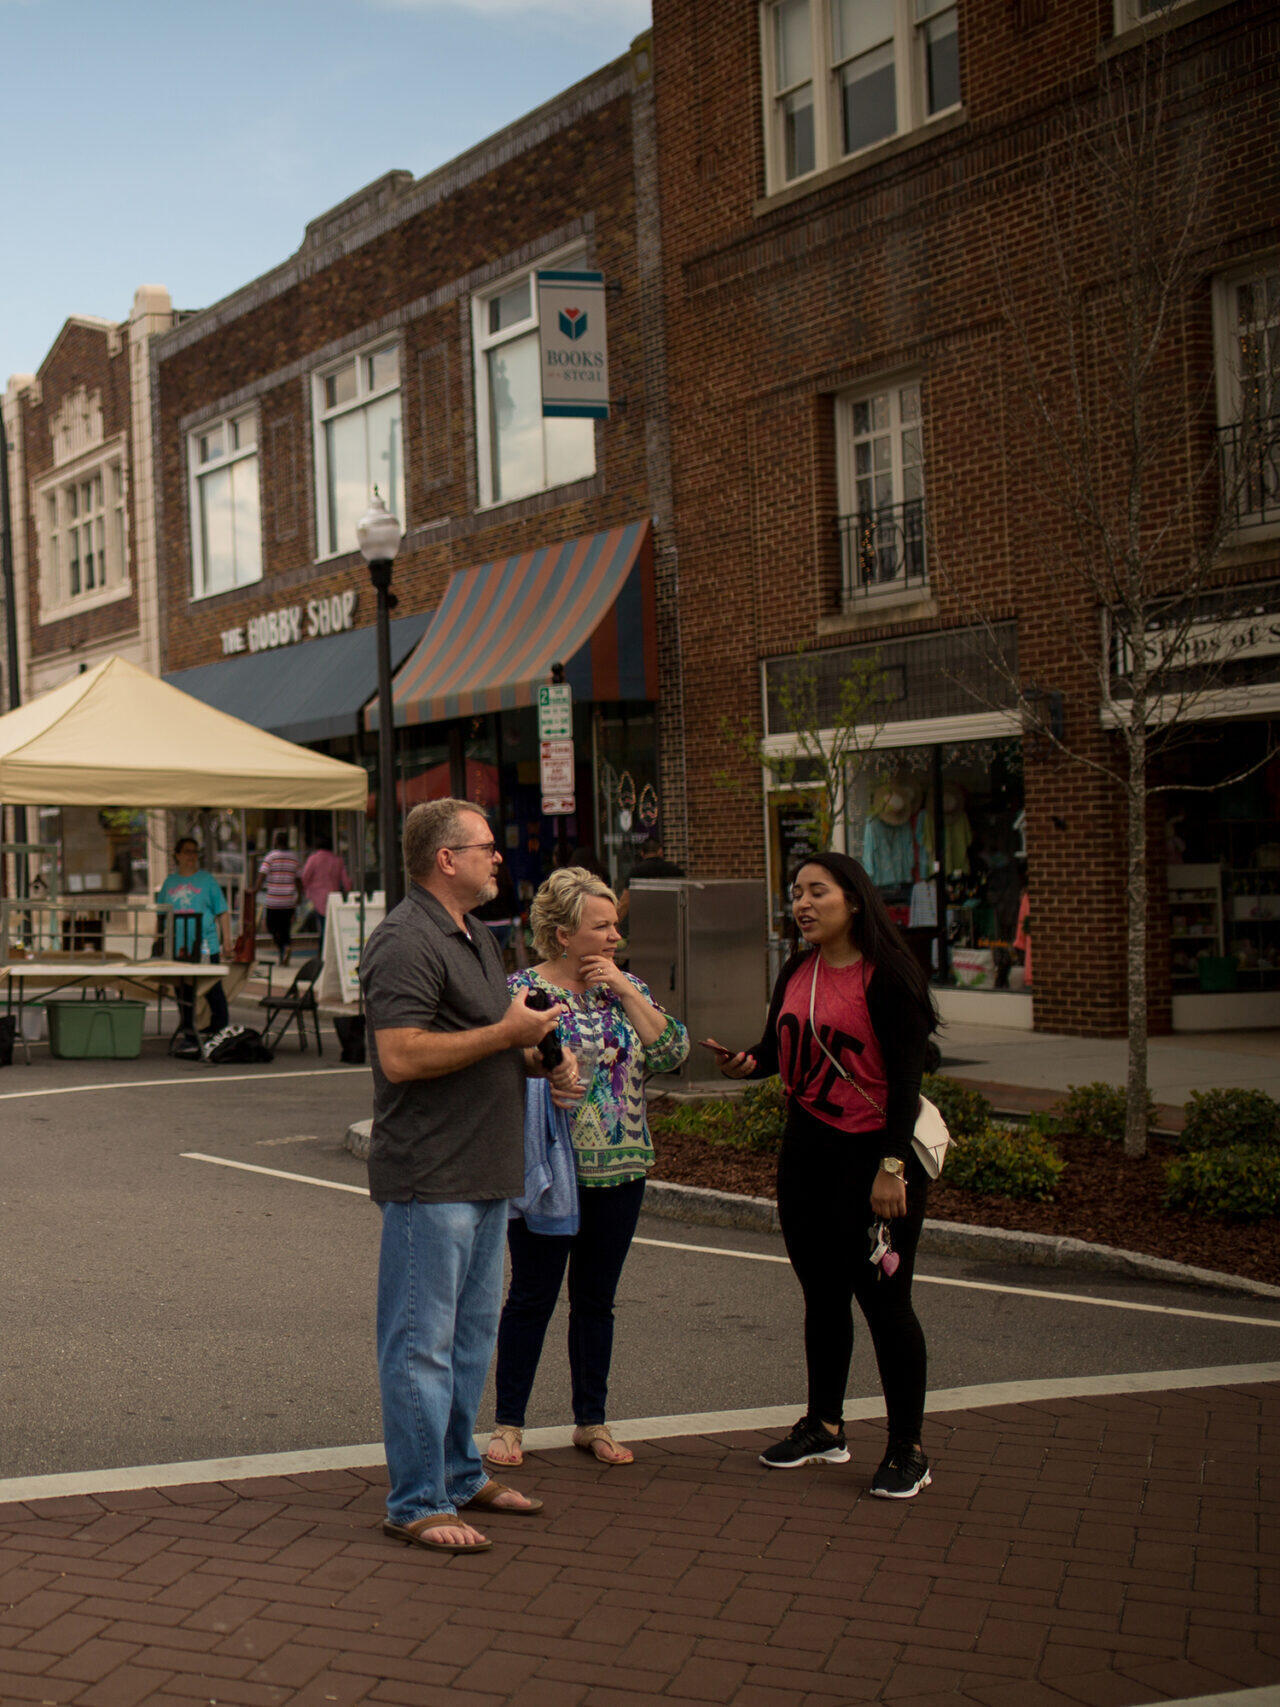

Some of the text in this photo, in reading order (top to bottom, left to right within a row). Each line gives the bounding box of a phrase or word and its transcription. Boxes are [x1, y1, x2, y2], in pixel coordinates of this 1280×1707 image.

[547, 350, 604, 367] BOOKS
[221, 590, 356, 655] THE HOBBY SHOP
[1232, 625, 1259, 648] of
[779, 1013, 866, 1118] OVE
